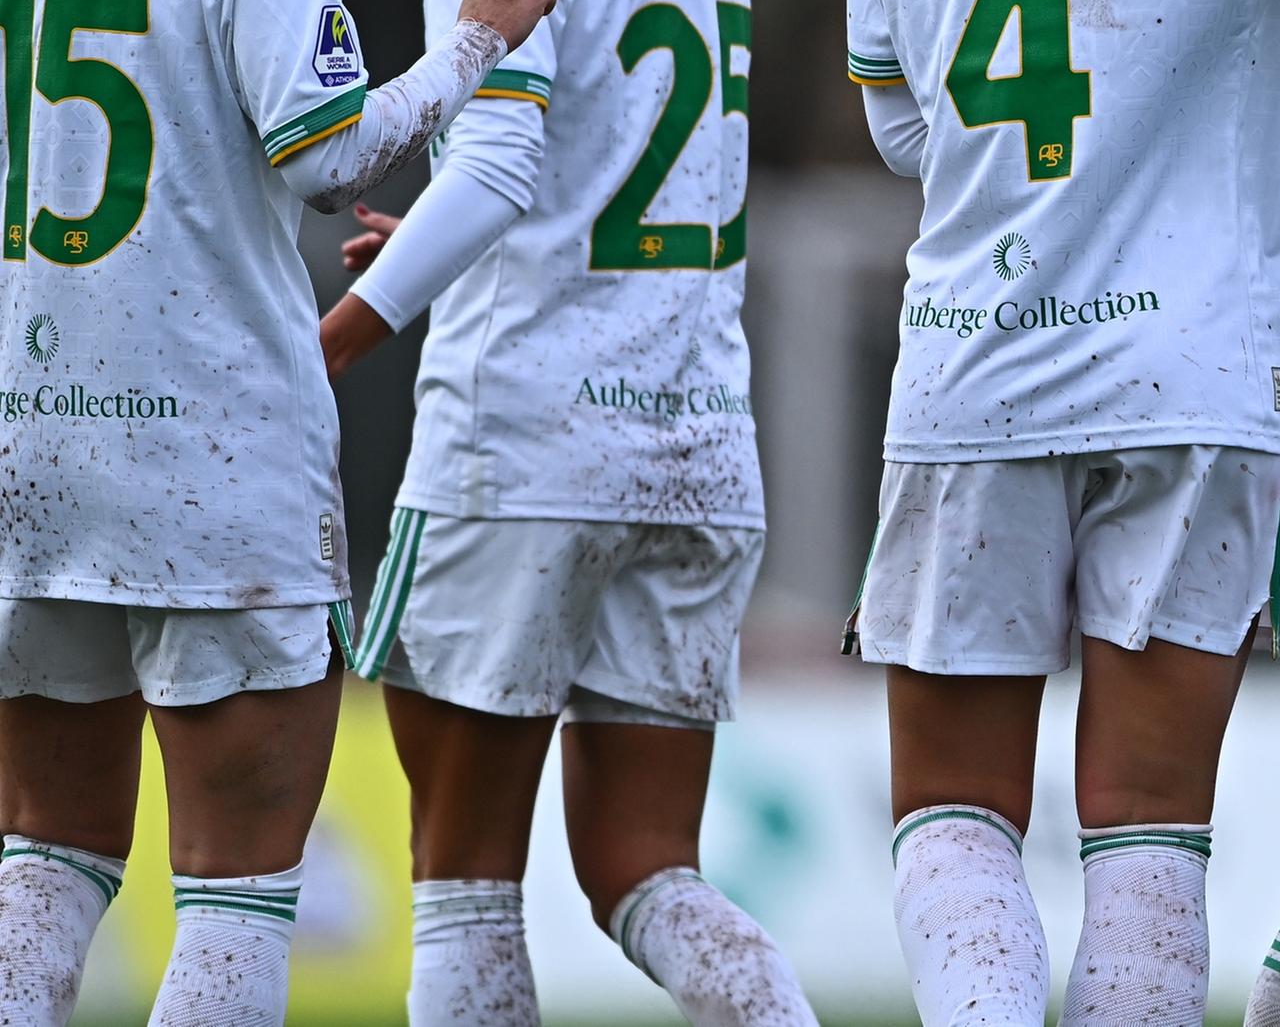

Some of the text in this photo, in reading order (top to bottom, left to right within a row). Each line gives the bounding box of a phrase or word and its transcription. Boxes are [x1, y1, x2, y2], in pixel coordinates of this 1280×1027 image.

[994, 289, 1161, 331] Collection
[35, 384, 180, 419] Collection
[575, 376, 684, 424] Auberge
